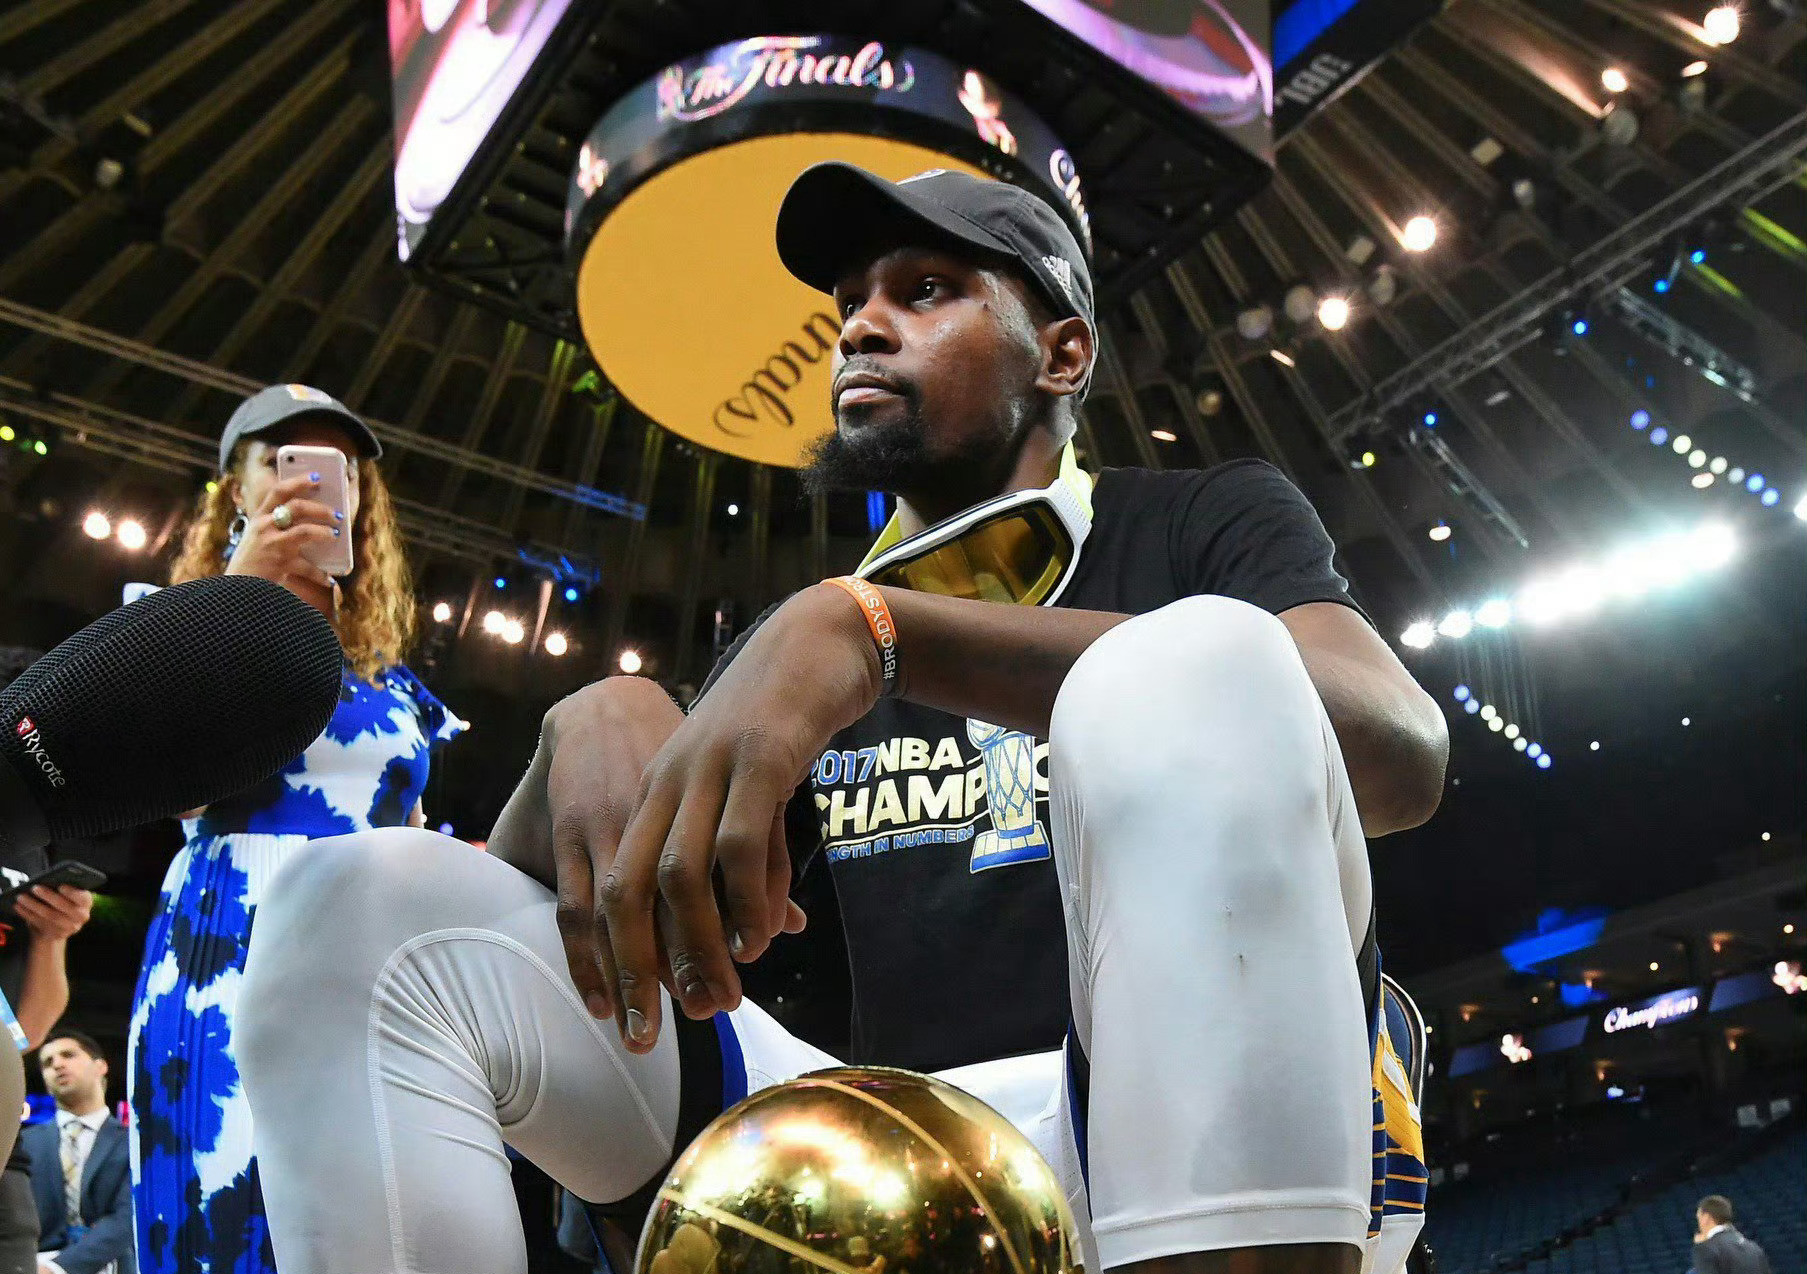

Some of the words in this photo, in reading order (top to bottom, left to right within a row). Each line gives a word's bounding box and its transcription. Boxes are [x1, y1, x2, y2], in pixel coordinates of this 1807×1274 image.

[674, 35, 915, 122] Finals
[713, 312, 842, 439] inals
[22, 728, 66, 788] Rycote
[875, 737, 965, 777] NBA
[827, 841, 873, 864] NGTH
[874, 836, 890, 855] IN
[893, 825, 975, 849] NUMBERS
